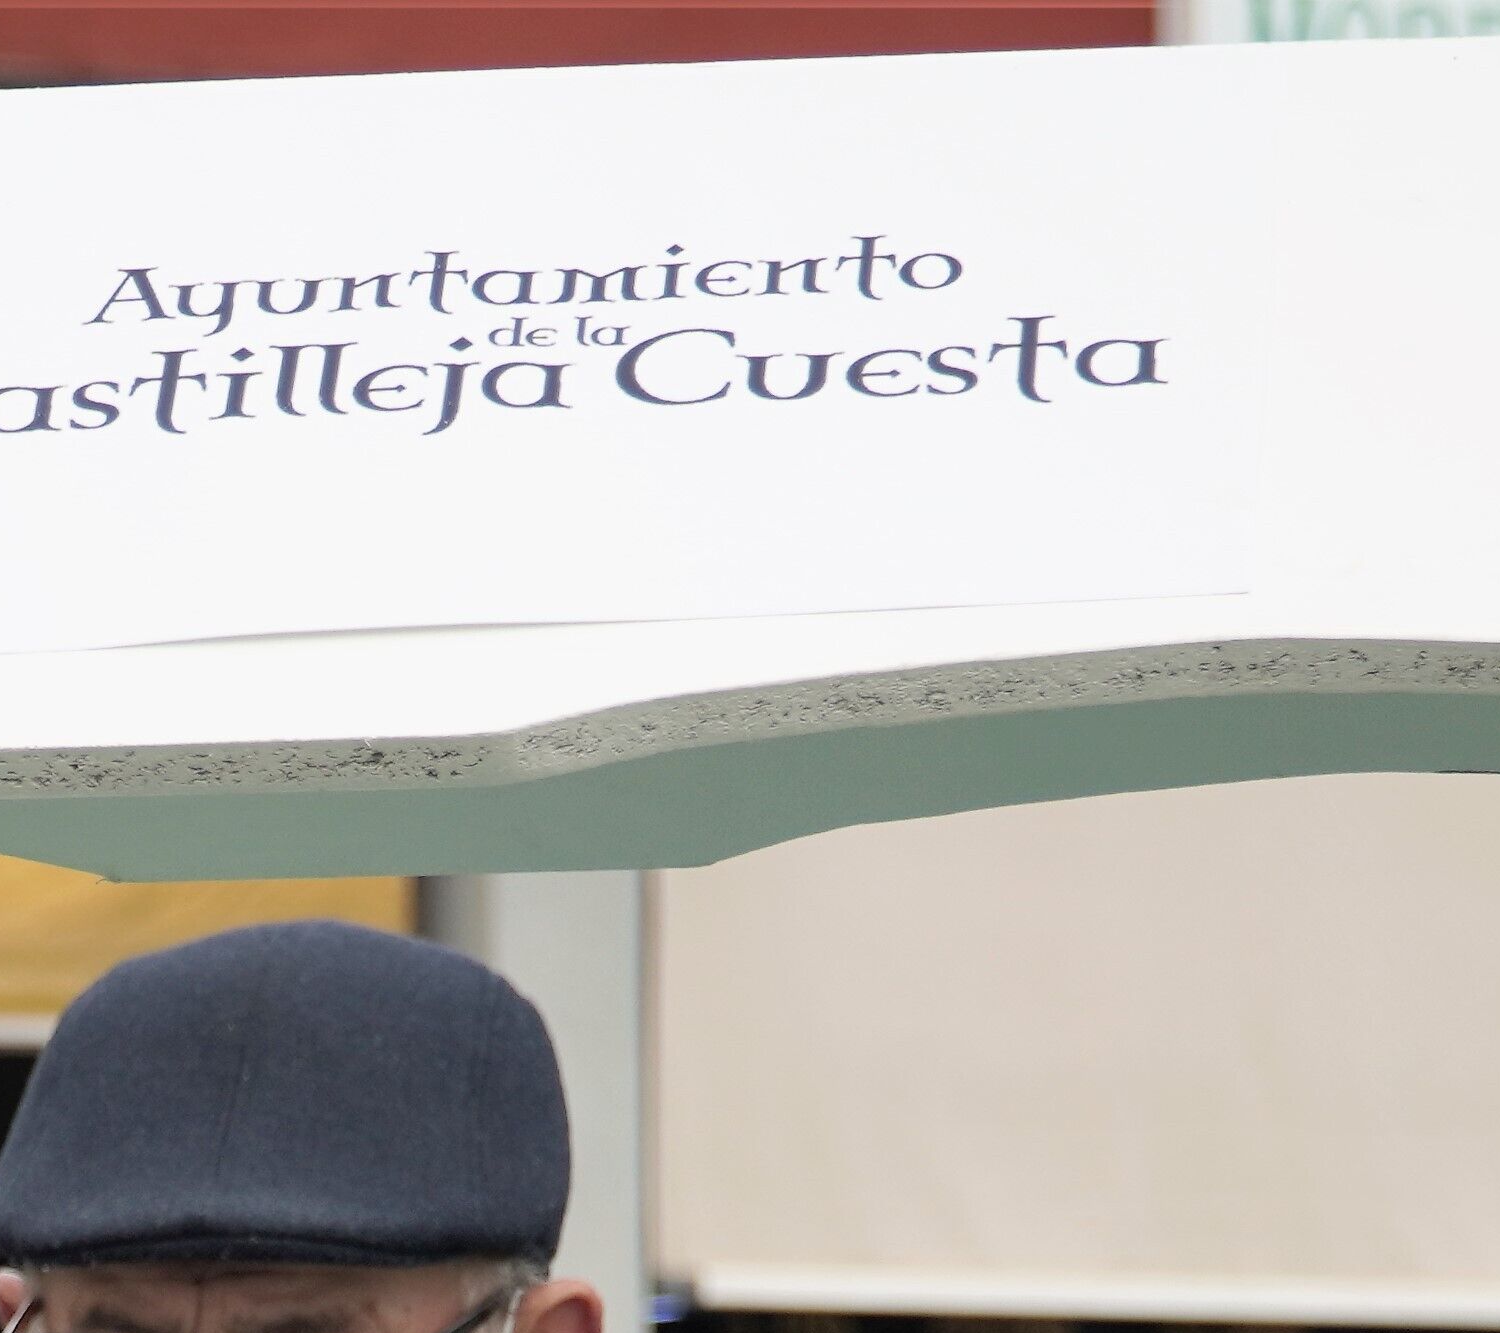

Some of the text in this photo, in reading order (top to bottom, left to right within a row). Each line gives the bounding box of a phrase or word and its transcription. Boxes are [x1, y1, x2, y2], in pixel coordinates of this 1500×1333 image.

[83, 235, 963, 337] Ayuntamiento
[487, 316, 632, 348] de la
[614, 315, 1170, 404] Cuesta
